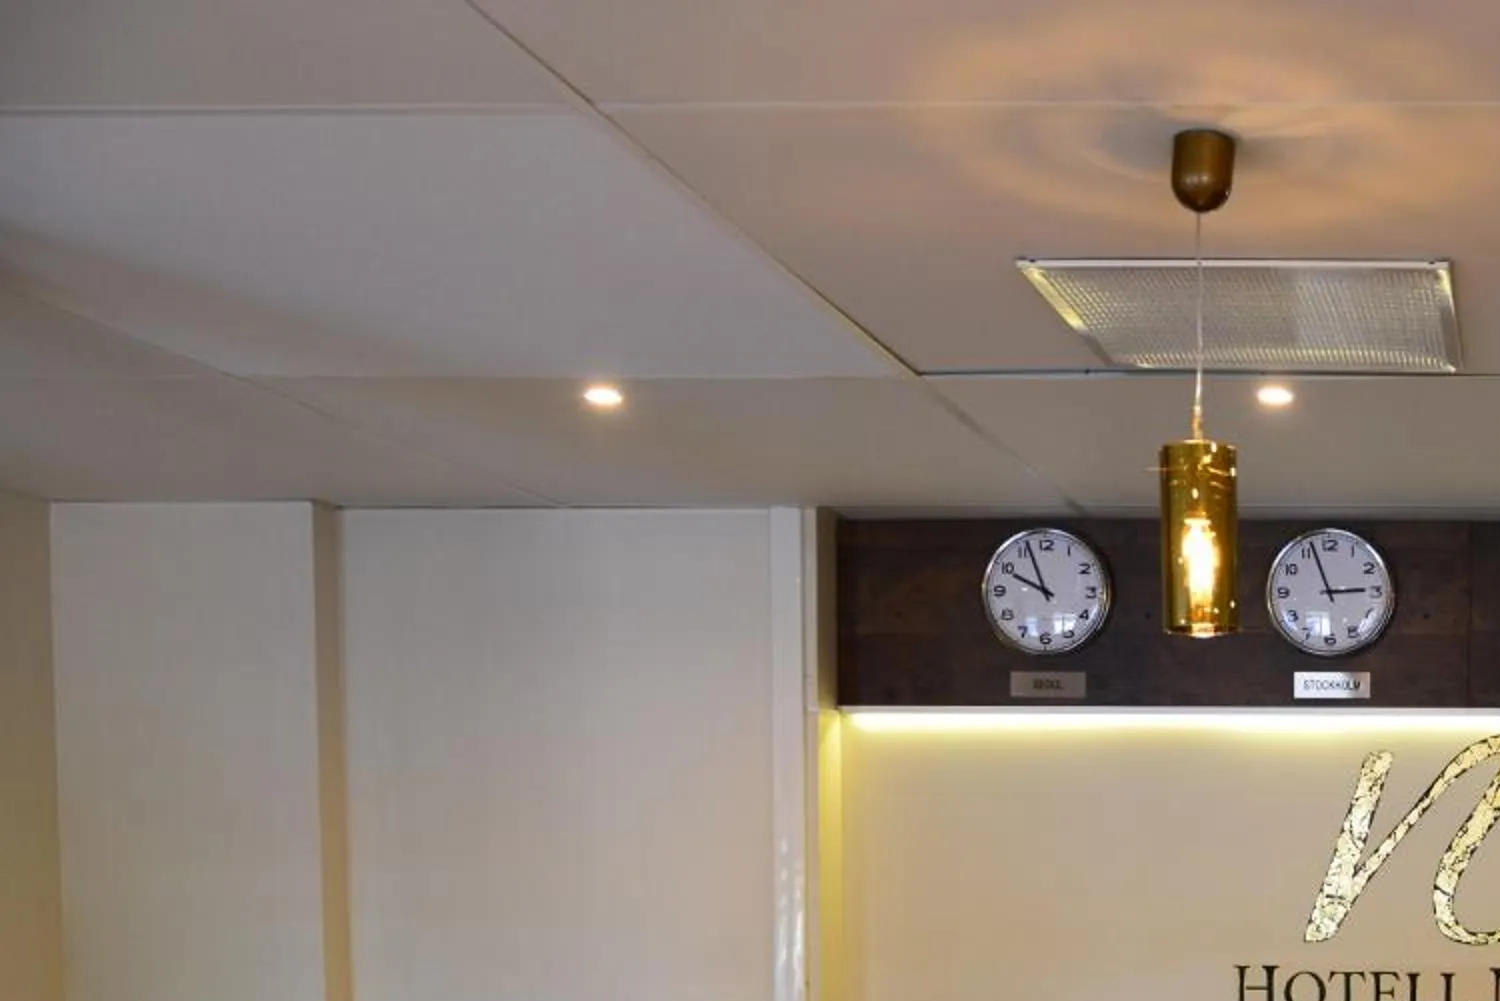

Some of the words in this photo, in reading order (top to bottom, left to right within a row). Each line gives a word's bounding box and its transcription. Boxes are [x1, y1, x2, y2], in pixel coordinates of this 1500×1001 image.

[1018, 545, 1028, 558] 11
[1039, 540, 1055, 551] 12
[1322, 540, 1339, 552] 12
[1301, 547, 1311, 559] 11
[1002, 562, 1014, 574] 10
[1079, 563, 1091, 575] 2
[1285, 563, 1298, 576] 10
[1363, 562, 1375, 575] 2
[993, 585, 1006, 597] 9
[1086, 586, 1097, 599] 3
[1277, 587, 1290, 599] 9
[1369, 585, 1382, 599] 3
[1001, 608, 1014, 621] 8
[1079, 609, 1089, 620] 4
[1018, 625, 1028, 638] 7
[1040, 632, 1052, 645] 6
[1324, 633, 1337, 645] 6
[1303, 679, 1361, 691] STOCKHOLM
